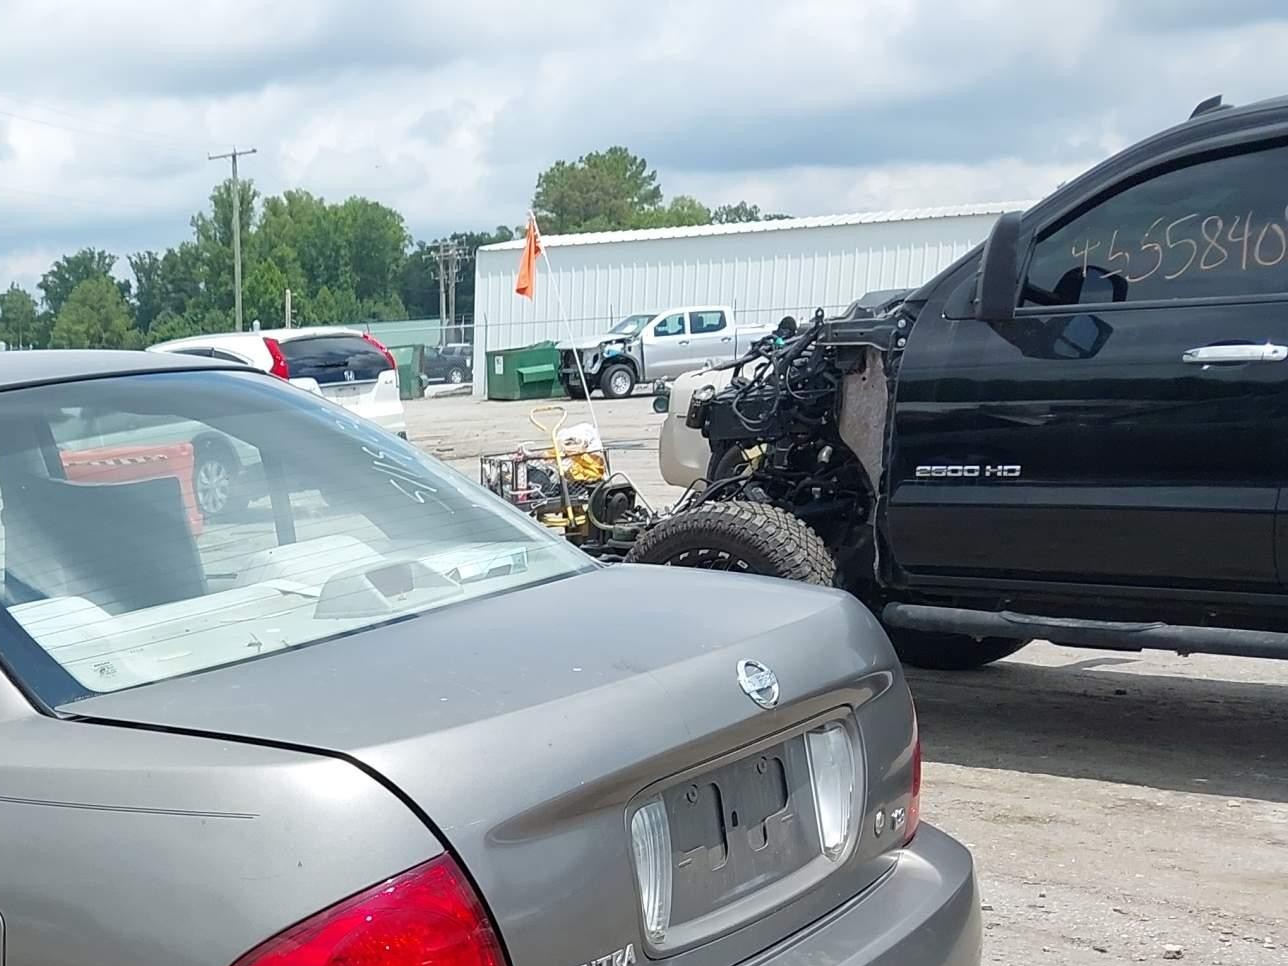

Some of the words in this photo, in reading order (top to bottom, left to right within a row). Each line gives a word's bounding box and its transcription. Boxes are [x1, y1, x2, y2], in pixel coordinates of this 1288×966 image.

[1071, 205, 1288, 282] 4555840
[915, 465, 980, 477] 2500
[985, 465, 1021, 477] HD
